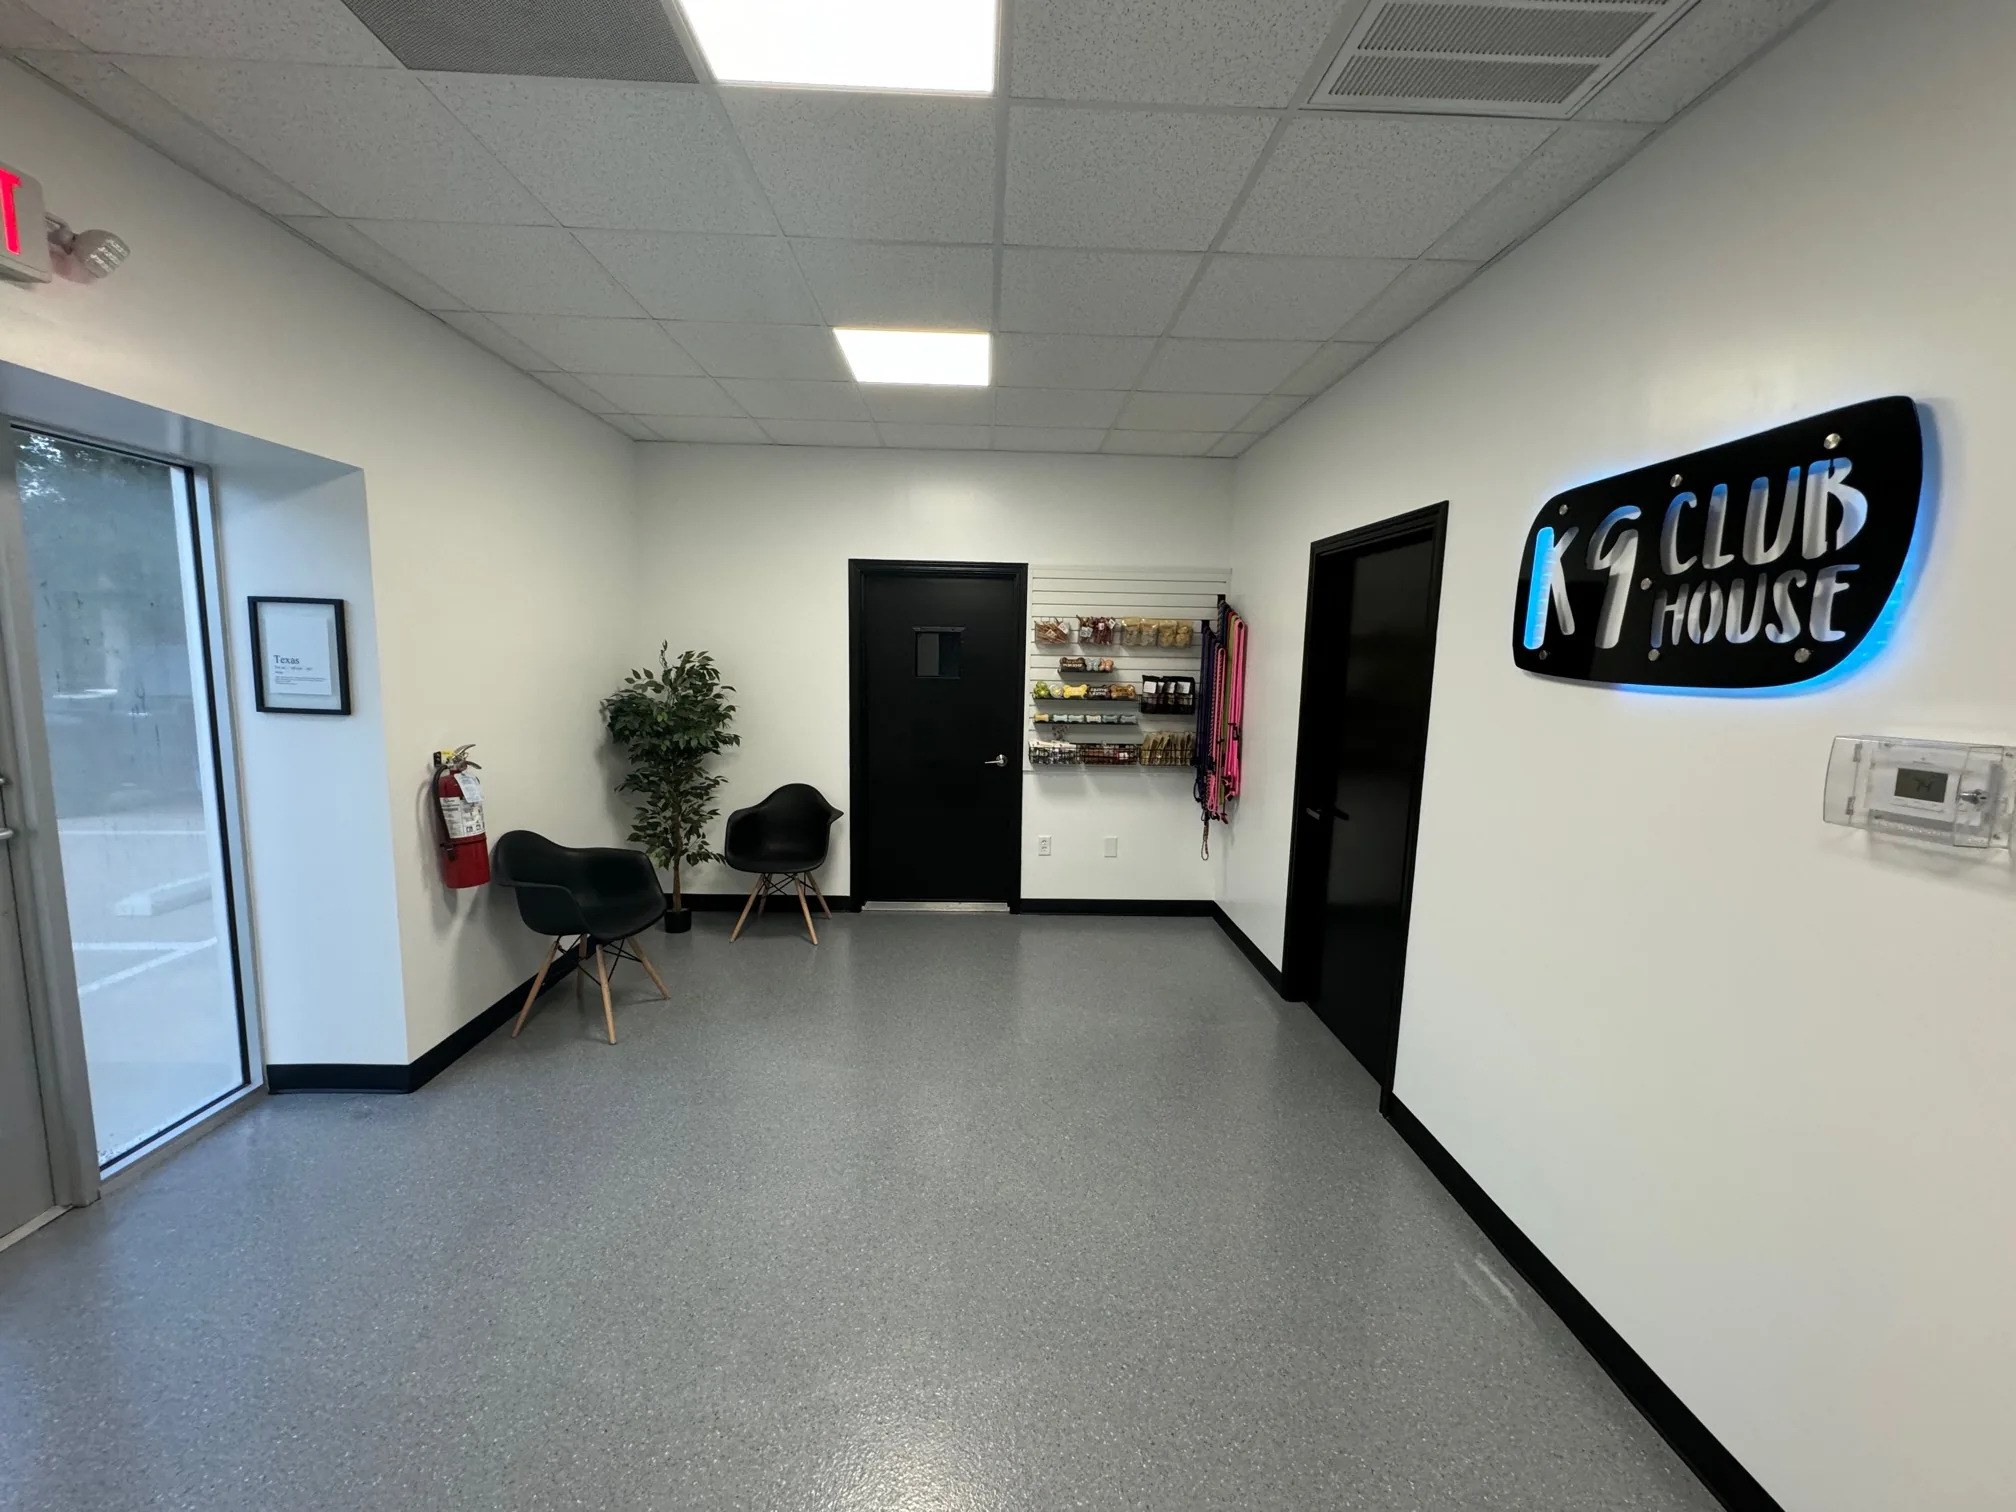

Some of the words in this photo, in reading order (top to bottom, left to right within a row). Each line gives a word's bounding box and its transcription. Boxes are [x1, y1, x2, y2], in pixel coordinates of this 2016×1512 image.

[1660, 456, 1868, 575] CLUB
[1650, 564, 1860, 649] HOUSE
[274, 654, 300, 665] Texas
